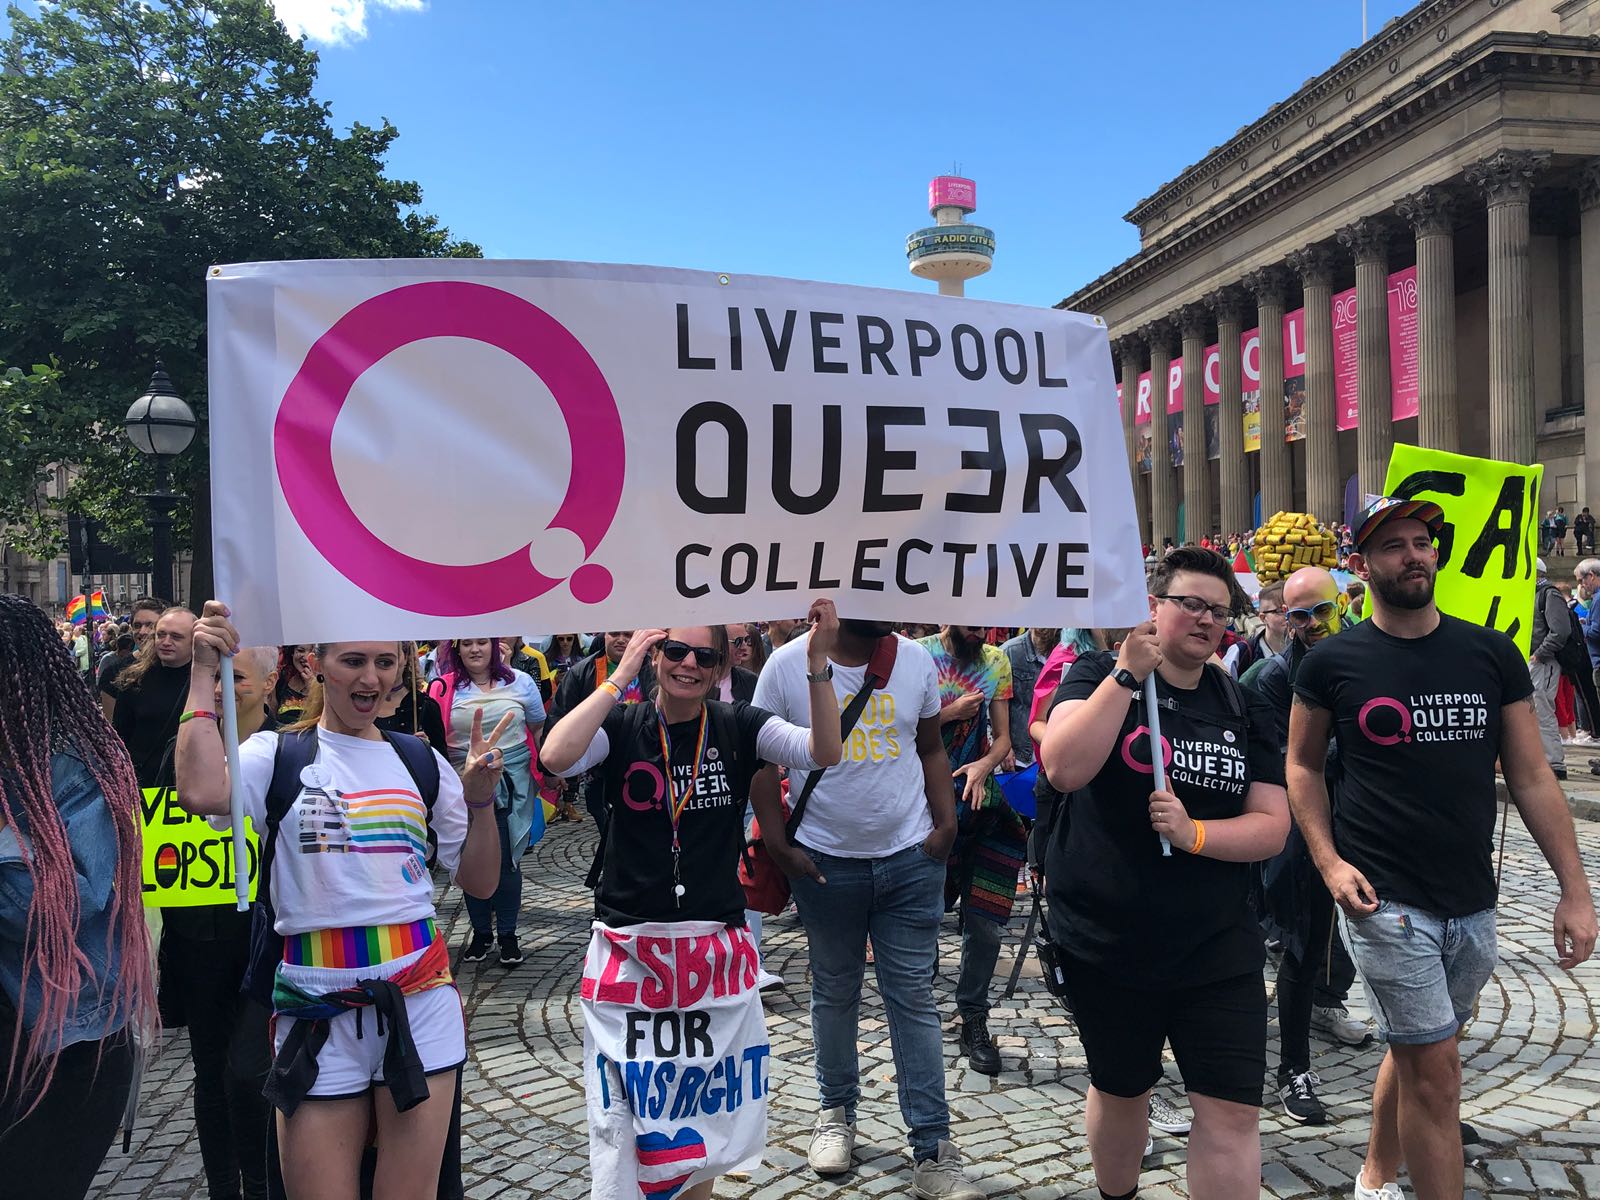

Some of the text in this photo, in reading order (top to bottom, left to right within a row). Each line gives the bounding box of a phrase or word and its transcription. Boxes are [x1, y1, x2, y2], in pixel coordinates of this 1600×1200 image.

[935, 235, 966, 243] RADIO
[970, 235, 988, 245] CITY
[676, 303, 1068, 388] LIVERPOOL
[676, 538, 1089, 598] COLLECTIVE
[843, 693, 895, 726] OD
[1410, 693, 1487, 706] LIVERPOOL
[843, 728, 901, 762] IBES
[1416, 729, 1486, 742] COLLECTIVE
[1173, 738, 1246, 759] LIVERPOOL
[671, 761, 726, 777] IVEPOO
[1172, 769, 1245, 795] COLLECTIVE
[676, 794, 732, 811] LECTIVE
[626, 1011, 713, 1059] FOR
